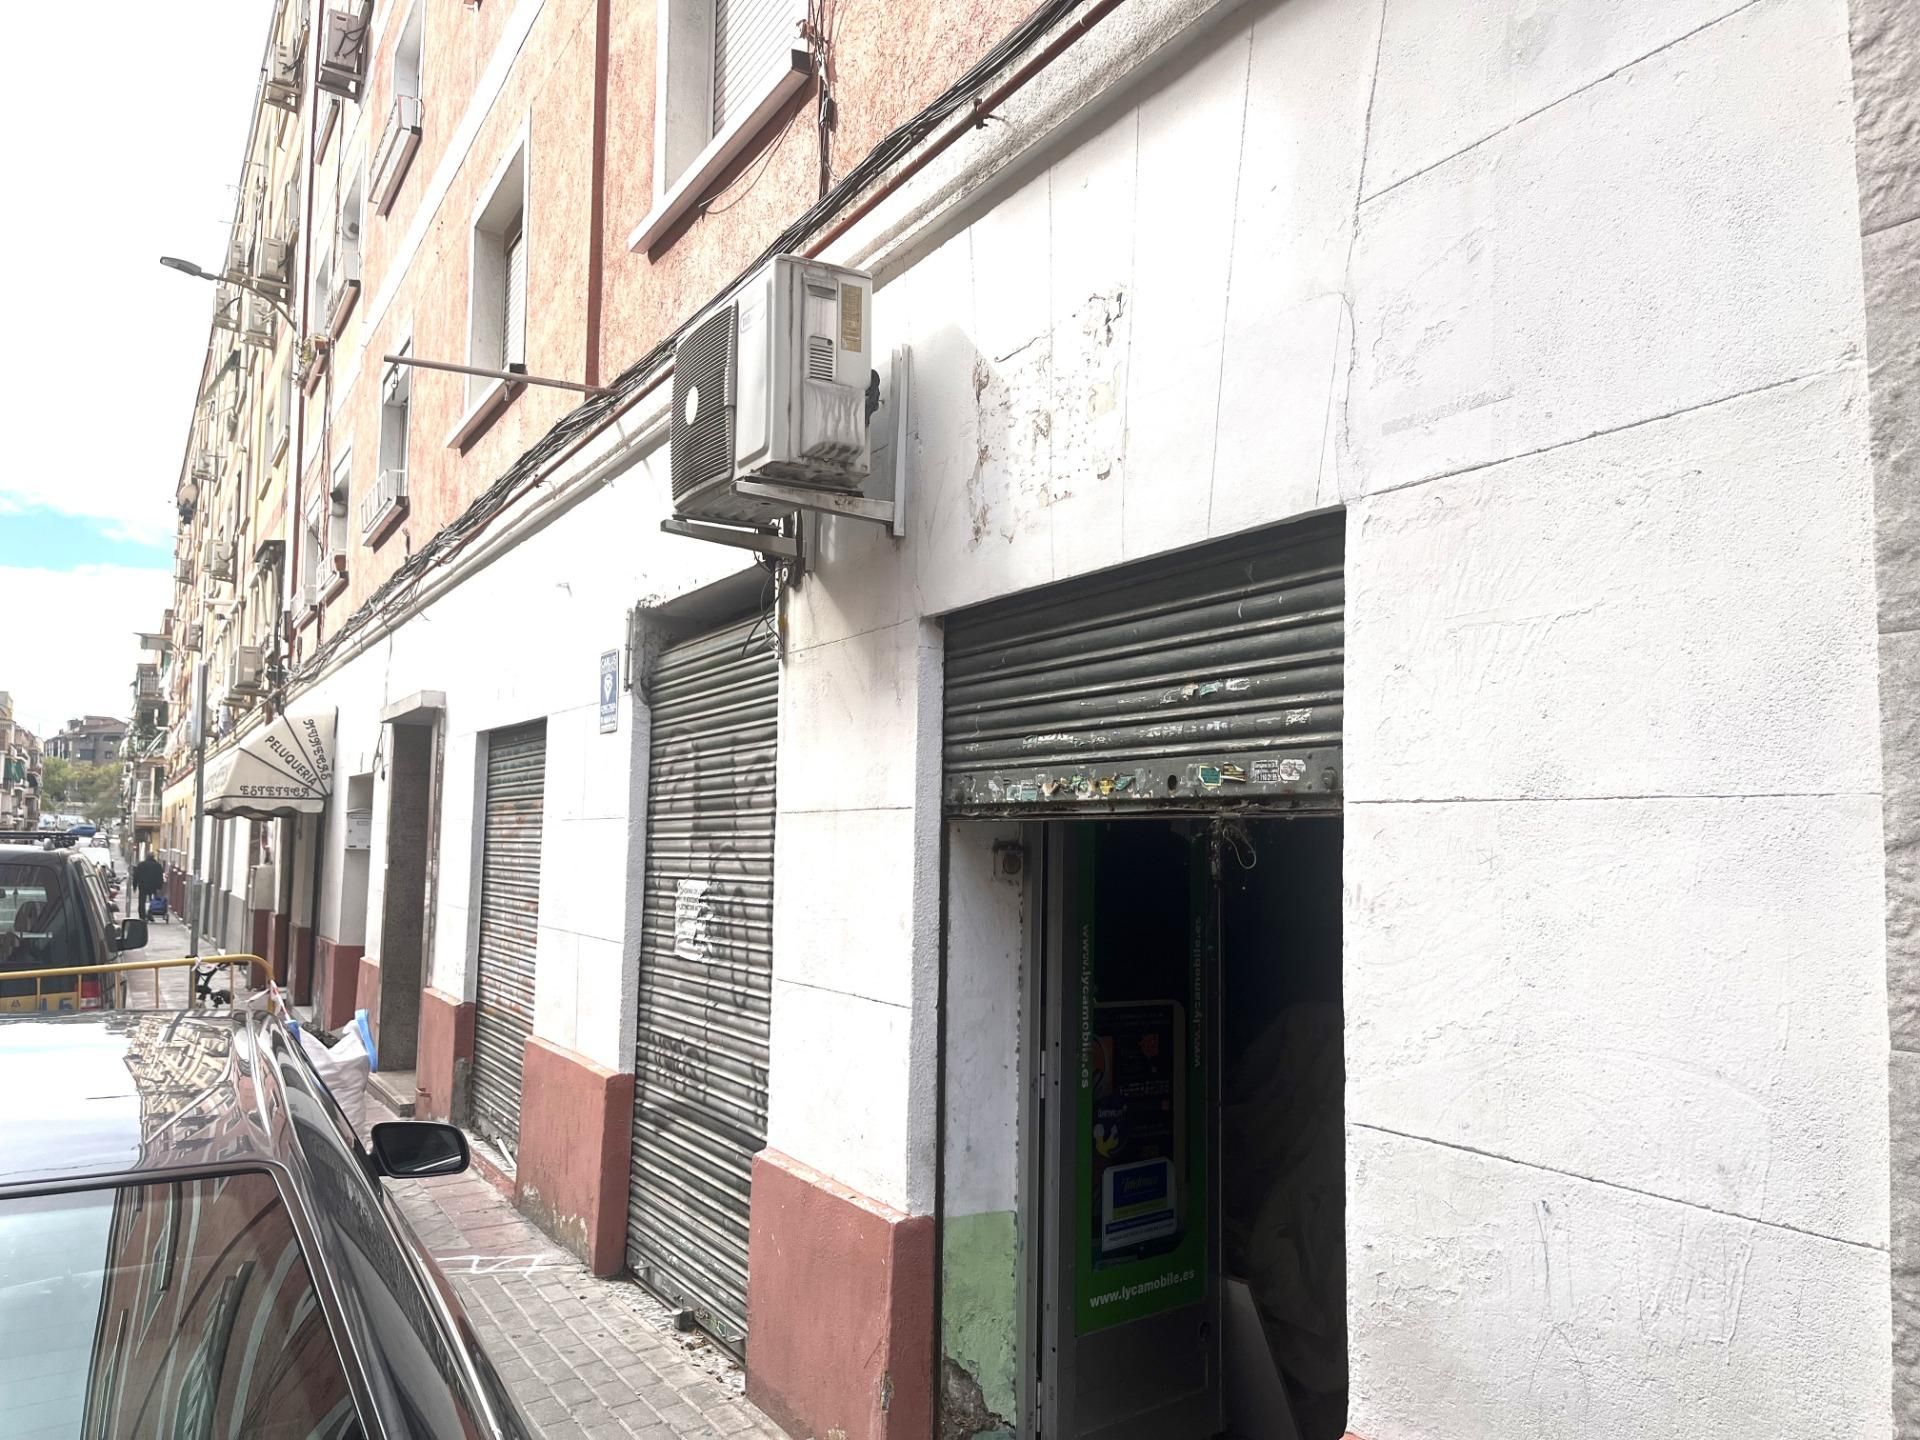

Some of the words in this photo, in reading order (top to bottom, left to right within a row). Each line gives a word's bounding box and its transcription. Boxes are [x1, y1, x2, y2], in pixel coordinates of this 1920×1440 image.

[264, 735, 318, 787] PELUQUERIA
[240, 785, 309, 797] ESTETICA
[1080, 926, 1091, 1088] www.lycamobile.es
[1089, 1269, 1195, 1308] www.lycamobile.es
